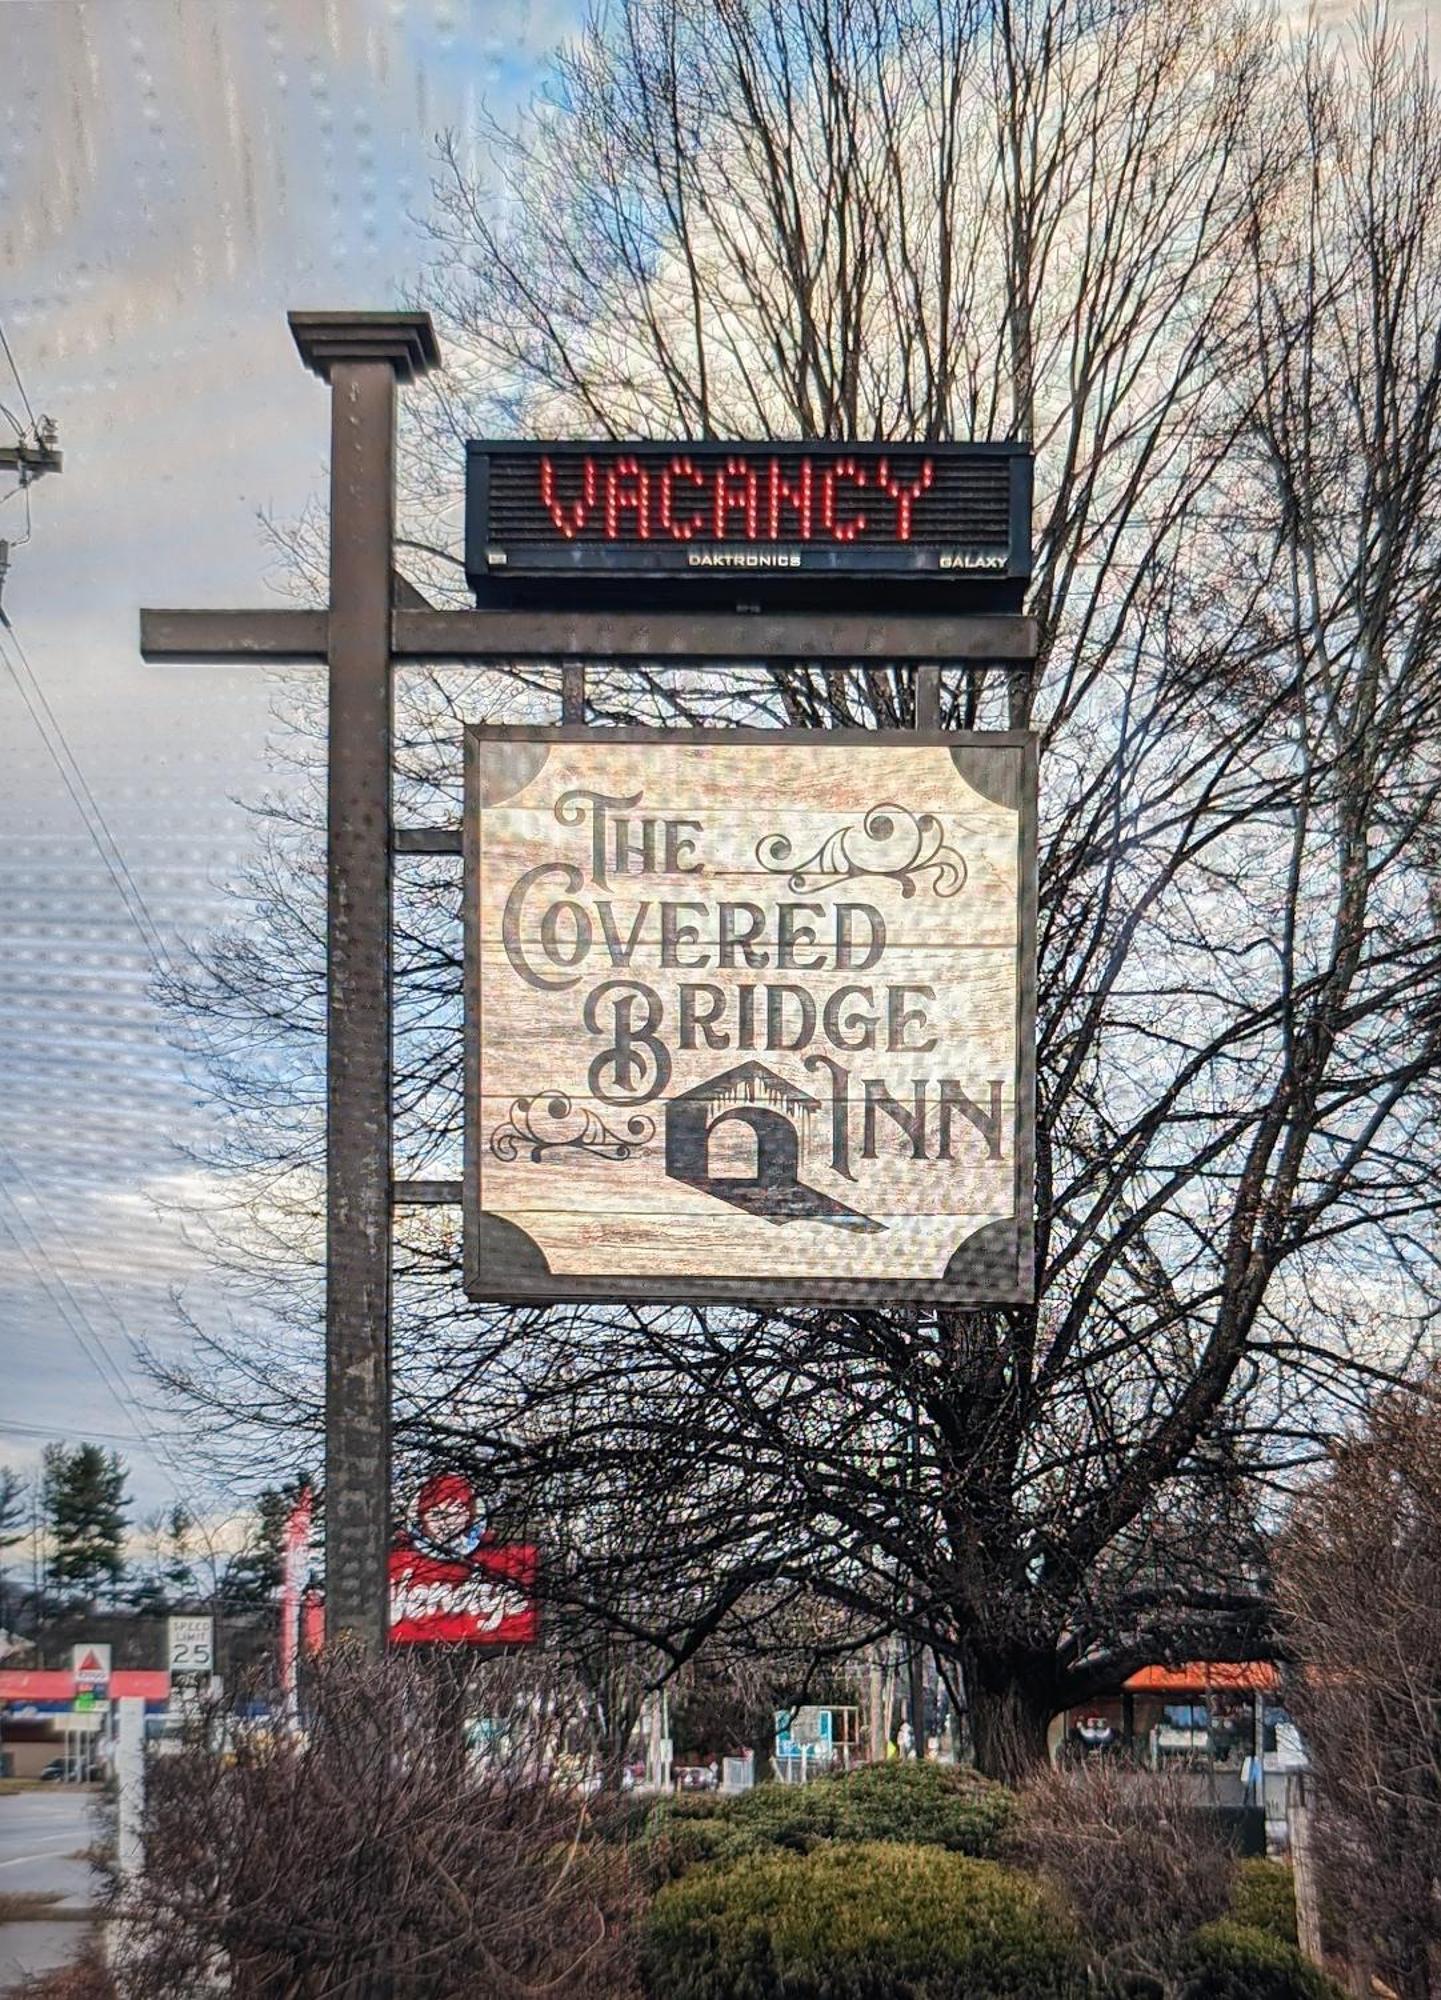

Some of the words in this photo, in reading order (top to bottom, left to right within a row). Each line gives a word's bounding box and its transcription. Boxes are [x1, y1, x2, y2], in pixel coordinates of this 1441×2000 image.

[540, 455, 934, 541] VACANCY
[688, 553, 801, 568] DAKTRONICS
[939, 554, 1008, 569] GALAXY
[502, 862, 887, 992] COVERED
[583, 979, 938, 1107] BRIDGE
[804, 1054, 1005, 1183] INN
[173, 1643, 210, 1664] 25
